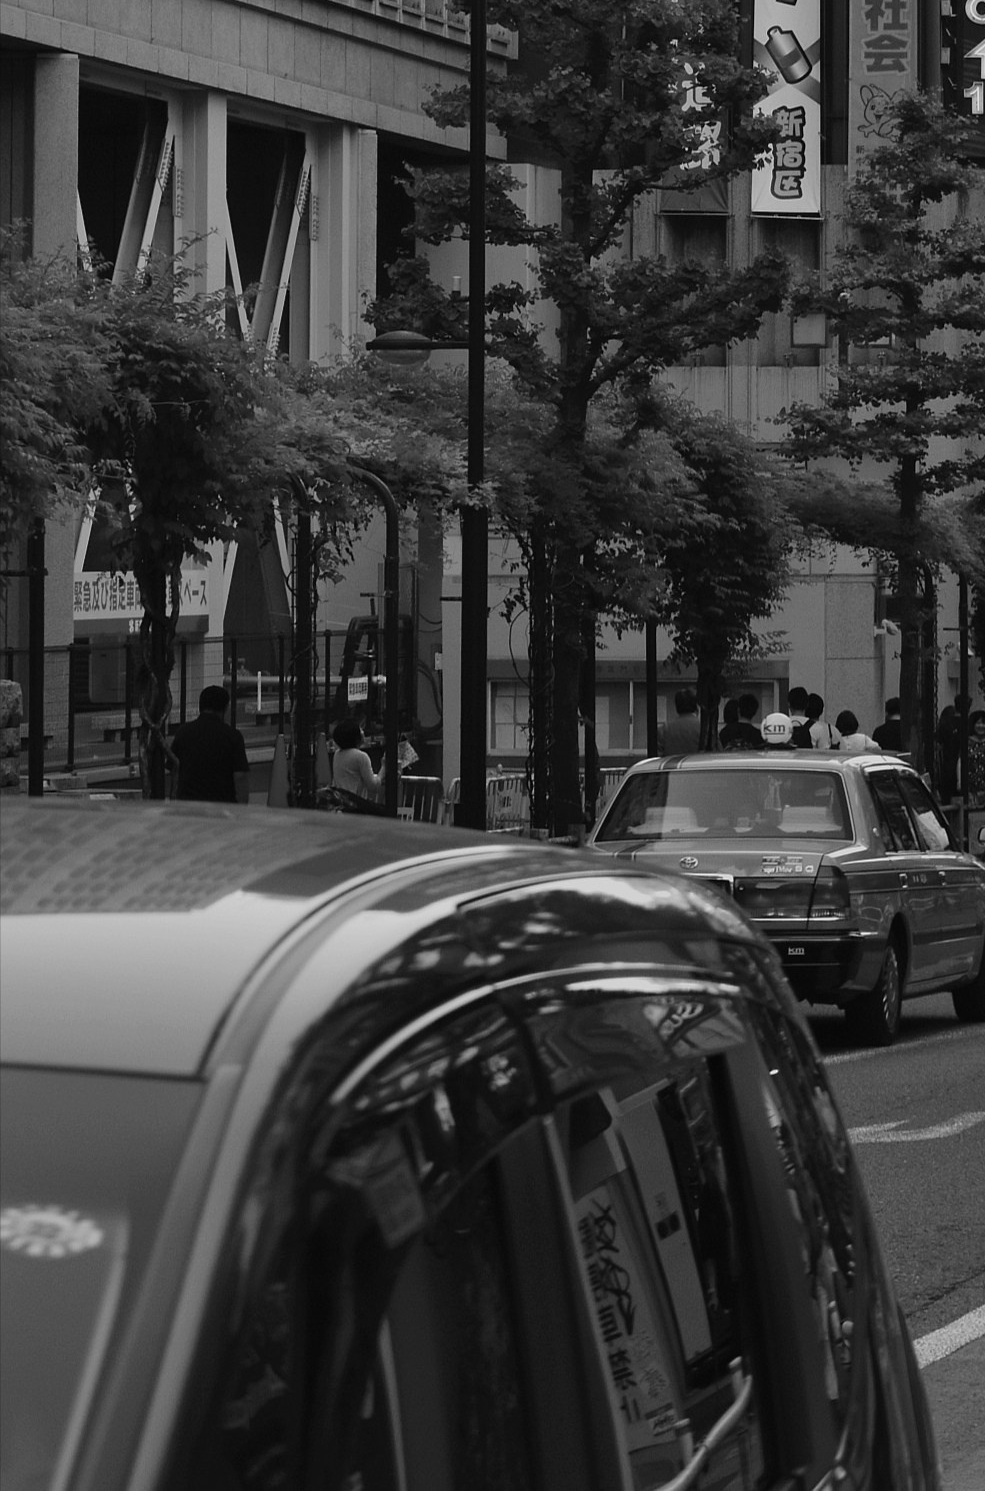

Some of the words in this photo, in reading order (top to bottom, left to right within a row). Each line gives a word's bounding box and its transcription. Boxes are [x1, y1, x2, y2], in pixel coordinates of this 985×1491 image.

[769, 105, 807, 202] 新宿区
[763, 723, 786, 735] km
